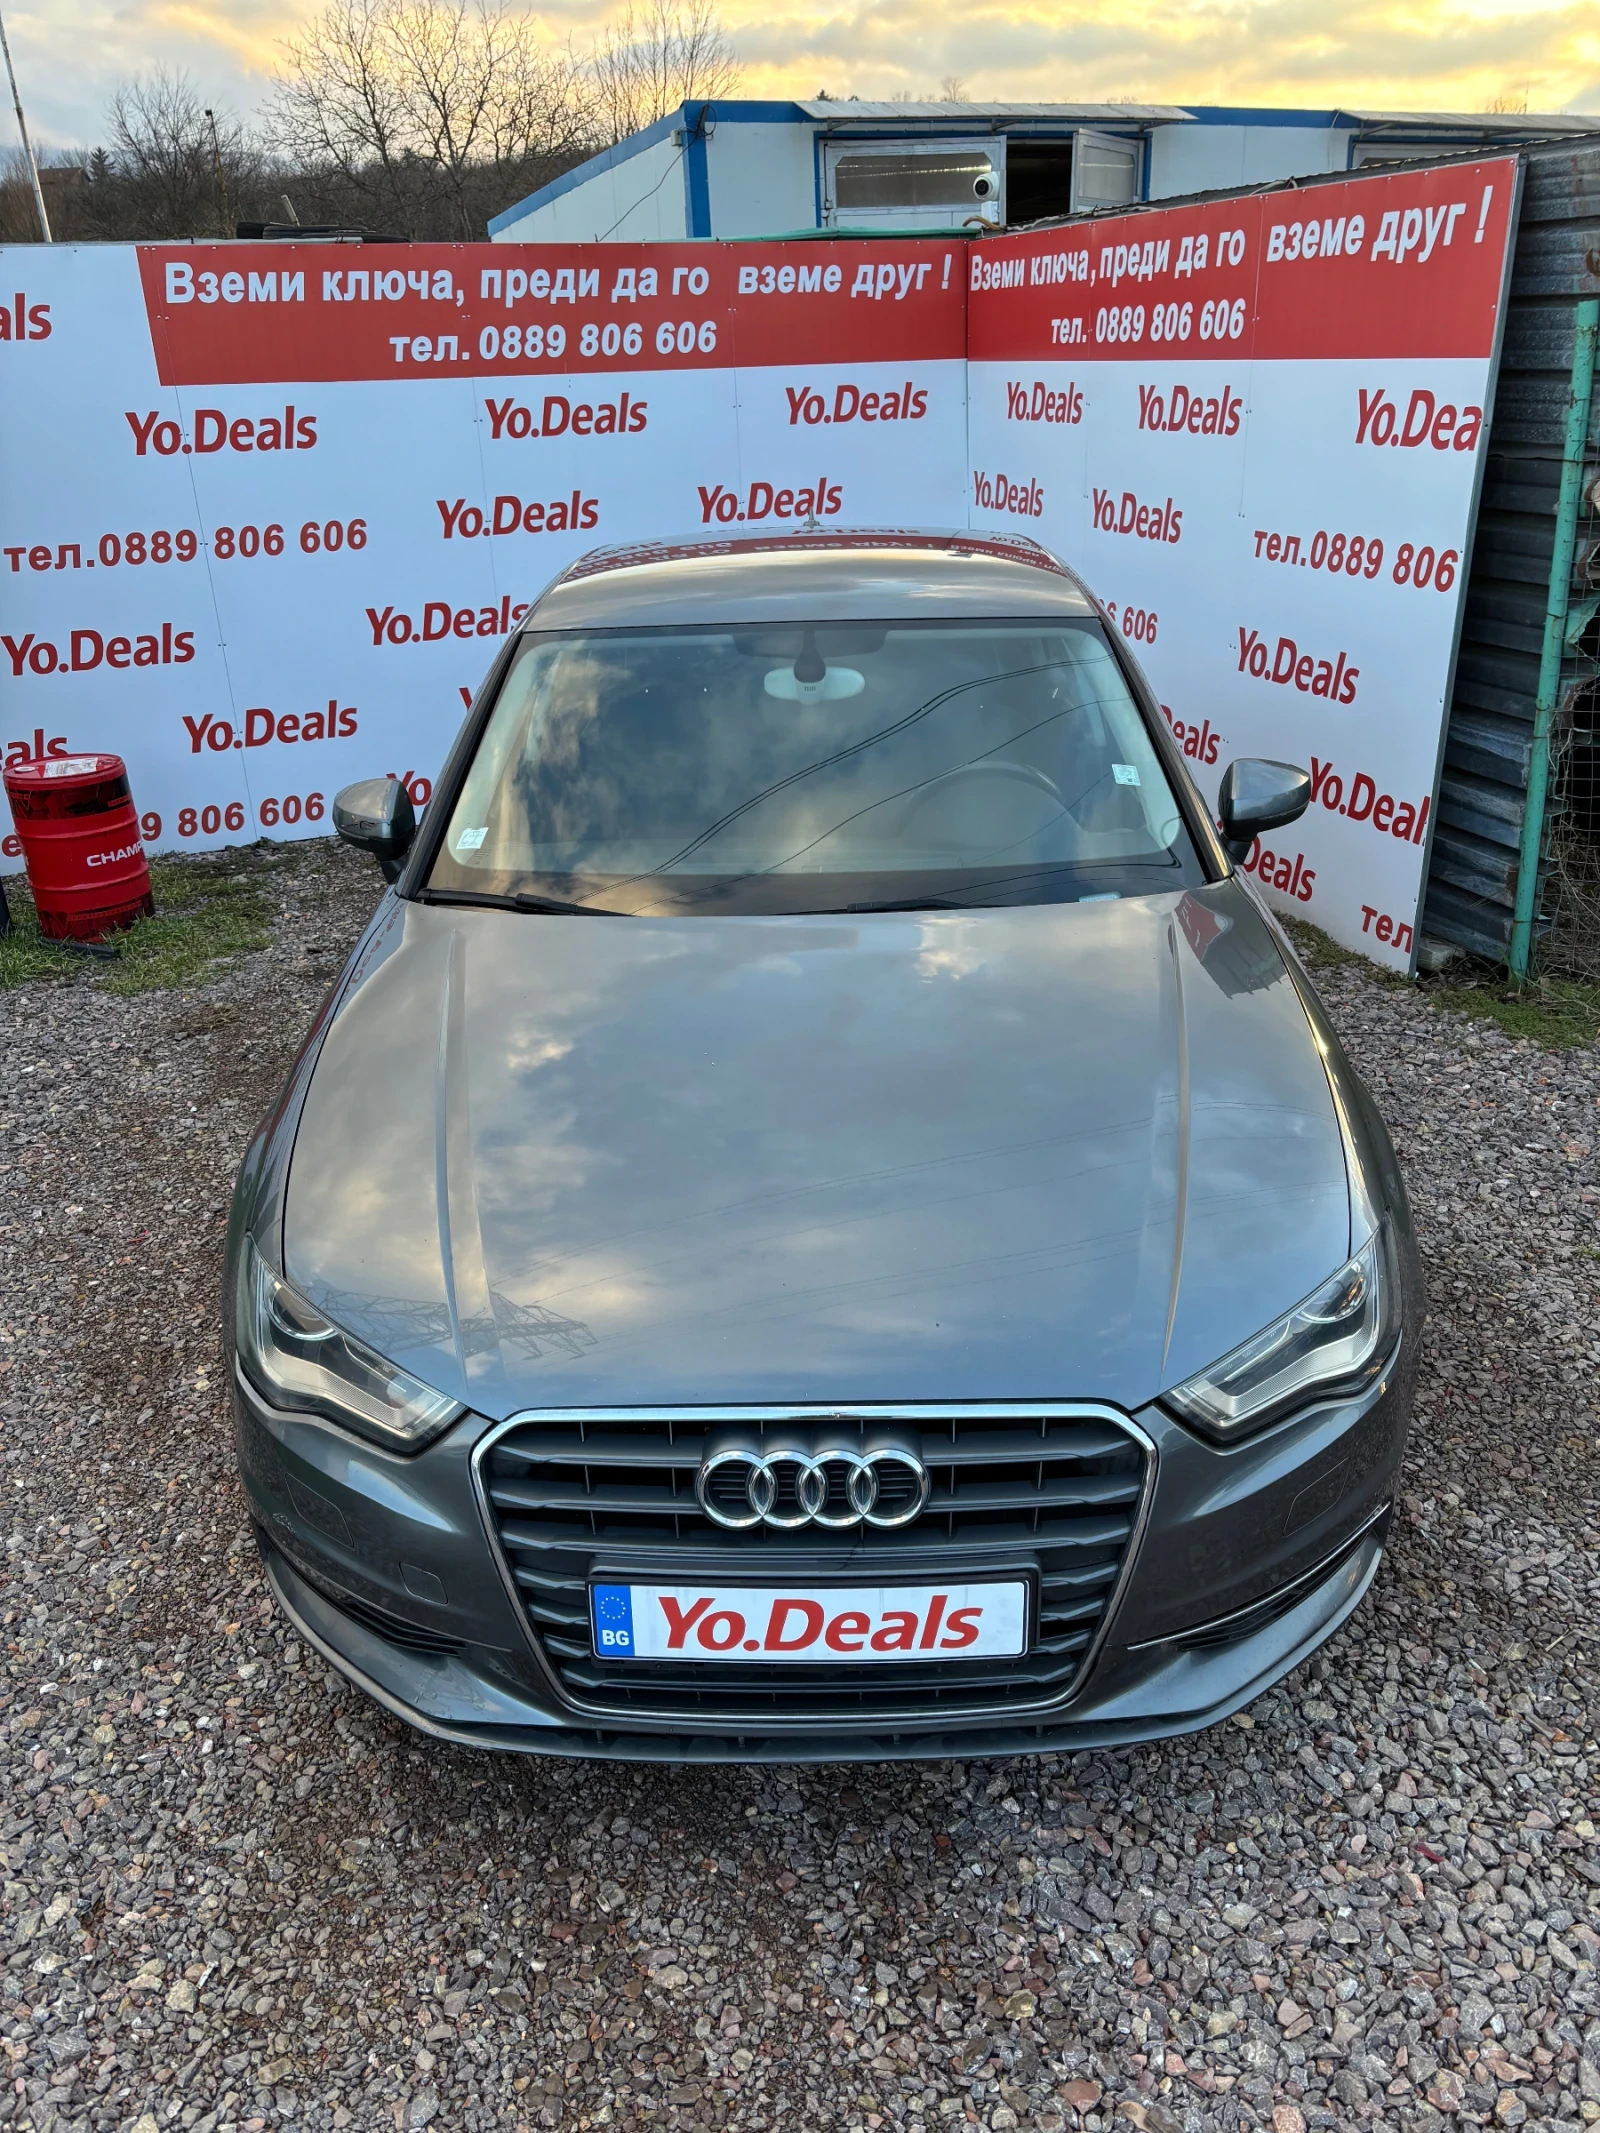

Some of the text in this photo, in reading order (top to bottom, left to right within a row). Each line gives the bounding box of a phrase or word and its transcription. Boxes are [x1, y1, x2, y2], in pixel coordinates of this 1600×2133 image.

[971, 255, 1025, 291] Вземи
[1174, 234, 1209, 279] да
[1215, 229, 1246, 267] го
[1266, 214, 1365, 262] вземе
[1370, 203, 1467, 264] друг
[1474, 185, 1494, 244] !
[165, 262, 305, 304] Вземи
[480, 268, 600, 308] преди
[611, 267, 658, 303] да
[672, 266, 709, 296] го
[738, 264, 842, 294] вземе
[851, 263, 932, 300] друг
[941, 254, 952, 289] !
[389, 320, 717, 362] тел. 0889 806 606
[1051, 298, 1246, 344] тел. 0889 806 606
[485, 392, 647, 439] Yo.Deals
[786, 382, 928, 425] Yo.Deals
[1007, 381, 1083, 424] Yo.Deals
[1139, 385, 1243, 436] Yo.Deals
[1356, 389, 1483, 452] Yo.Dea
[125, 405, 317, 456] Yo.Deals
[437, 490, 598, 539] Yo.Deals
[697, 478, 842, 523] Yo.Deals
[974, 471, 1044, 517] Yo.Deals
[1092, 487, 1183, 544] Yo.Deals
[214, 524, 284, 559] 806
[300, 519, 367, 553] 606
[1392, 543, 1459, 593] 806
[0, 623, 195, 676] Yo.Deals
[1122, 606, 1158, 644] 606
[1238, 627, 1359, 704] Yo.Deals
[183, 700, 357, 753] Yo.Deals
[178, 803, 244, 837] 806
[260, 793, 324, 826] 606
[601, 1629, 631, 1647] BG
[658, 1595, 983, 1653] Yo.Deals
